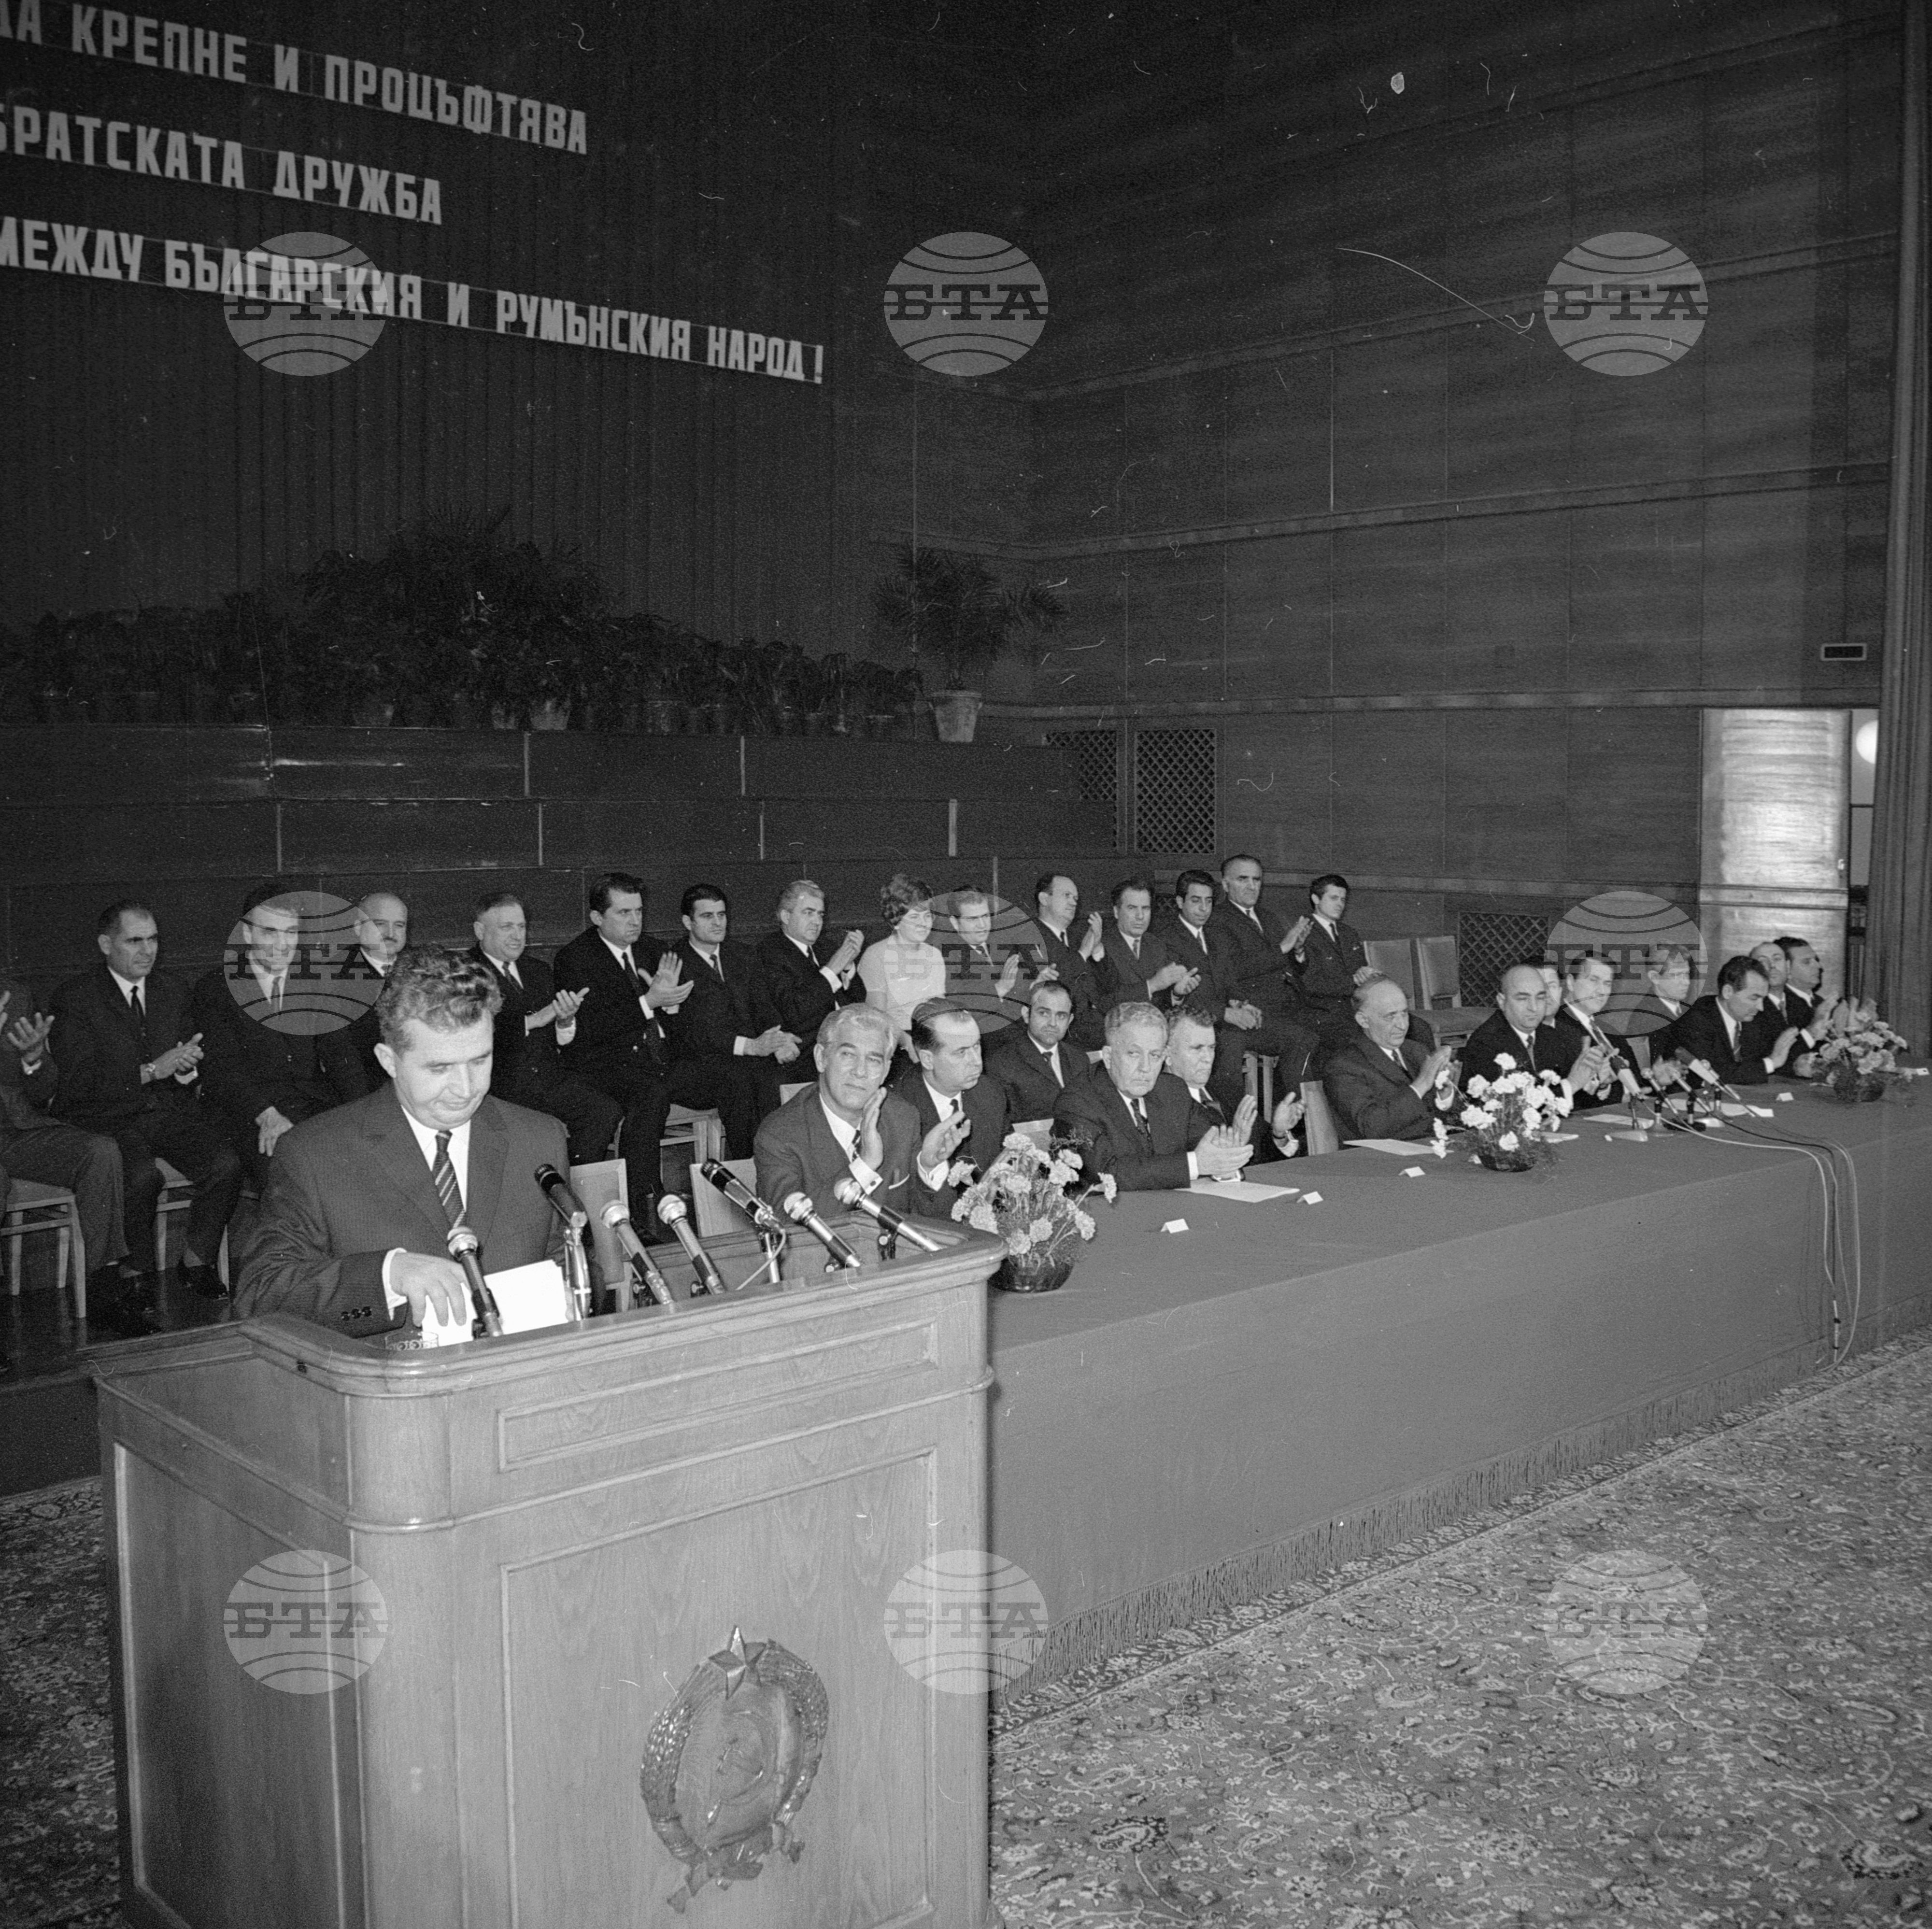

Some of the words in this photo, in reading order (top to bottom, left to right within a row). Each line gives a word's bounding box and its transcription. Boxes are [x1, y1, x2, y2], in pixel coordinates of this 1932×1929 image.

[72, 3, 247, 83] КРЕПНЕ
[274, 43, 299, 93] И
[325, 54, 587, 155] ПРОЦЪФТЯВА
[273, 150, 441, 225] ДРУЖБА
[165, 239, 422, 320] БЪЛГАРСКИЯ
[447, 282, 469, 328] И
[496, 290, 691, 362] РУМЪНСКИЯ
